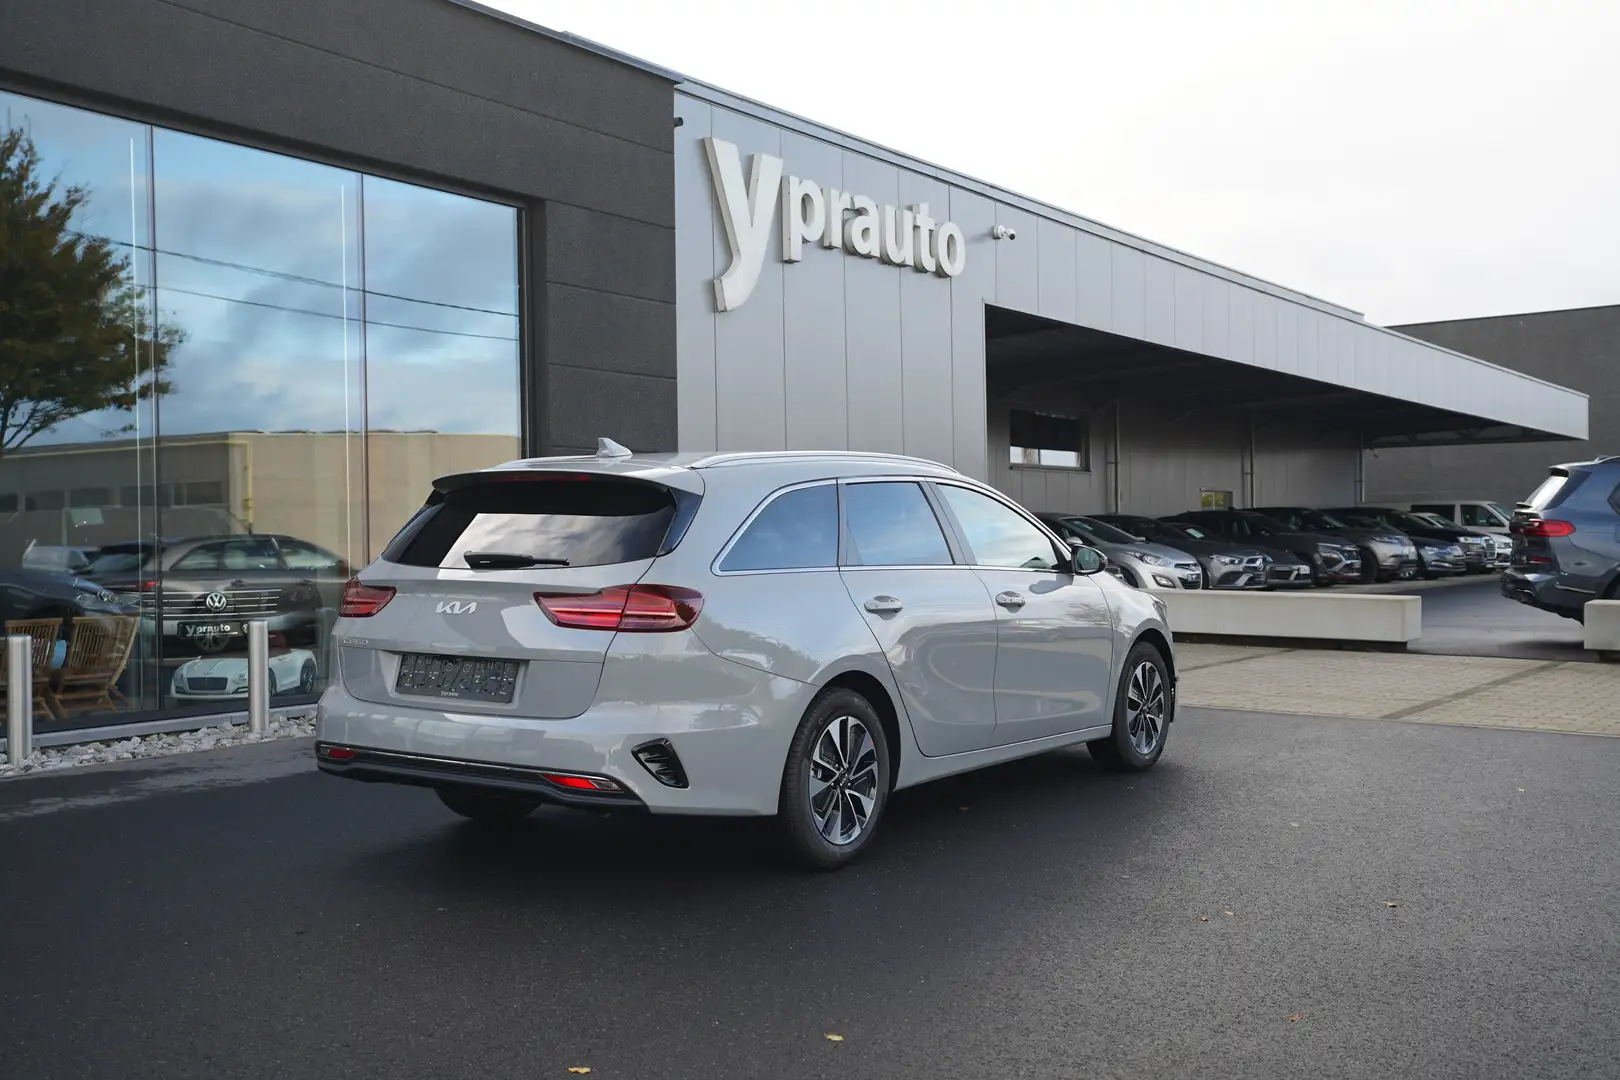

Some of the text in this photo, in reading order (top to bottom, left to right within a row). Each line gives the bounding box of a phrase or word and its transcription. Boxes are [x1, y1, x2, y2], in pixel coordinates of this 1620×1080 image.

[703, 137, 966, 312] yprauto
[436, 601, 477, 615] KIA
[186, 623, 231, 637] yprauto
